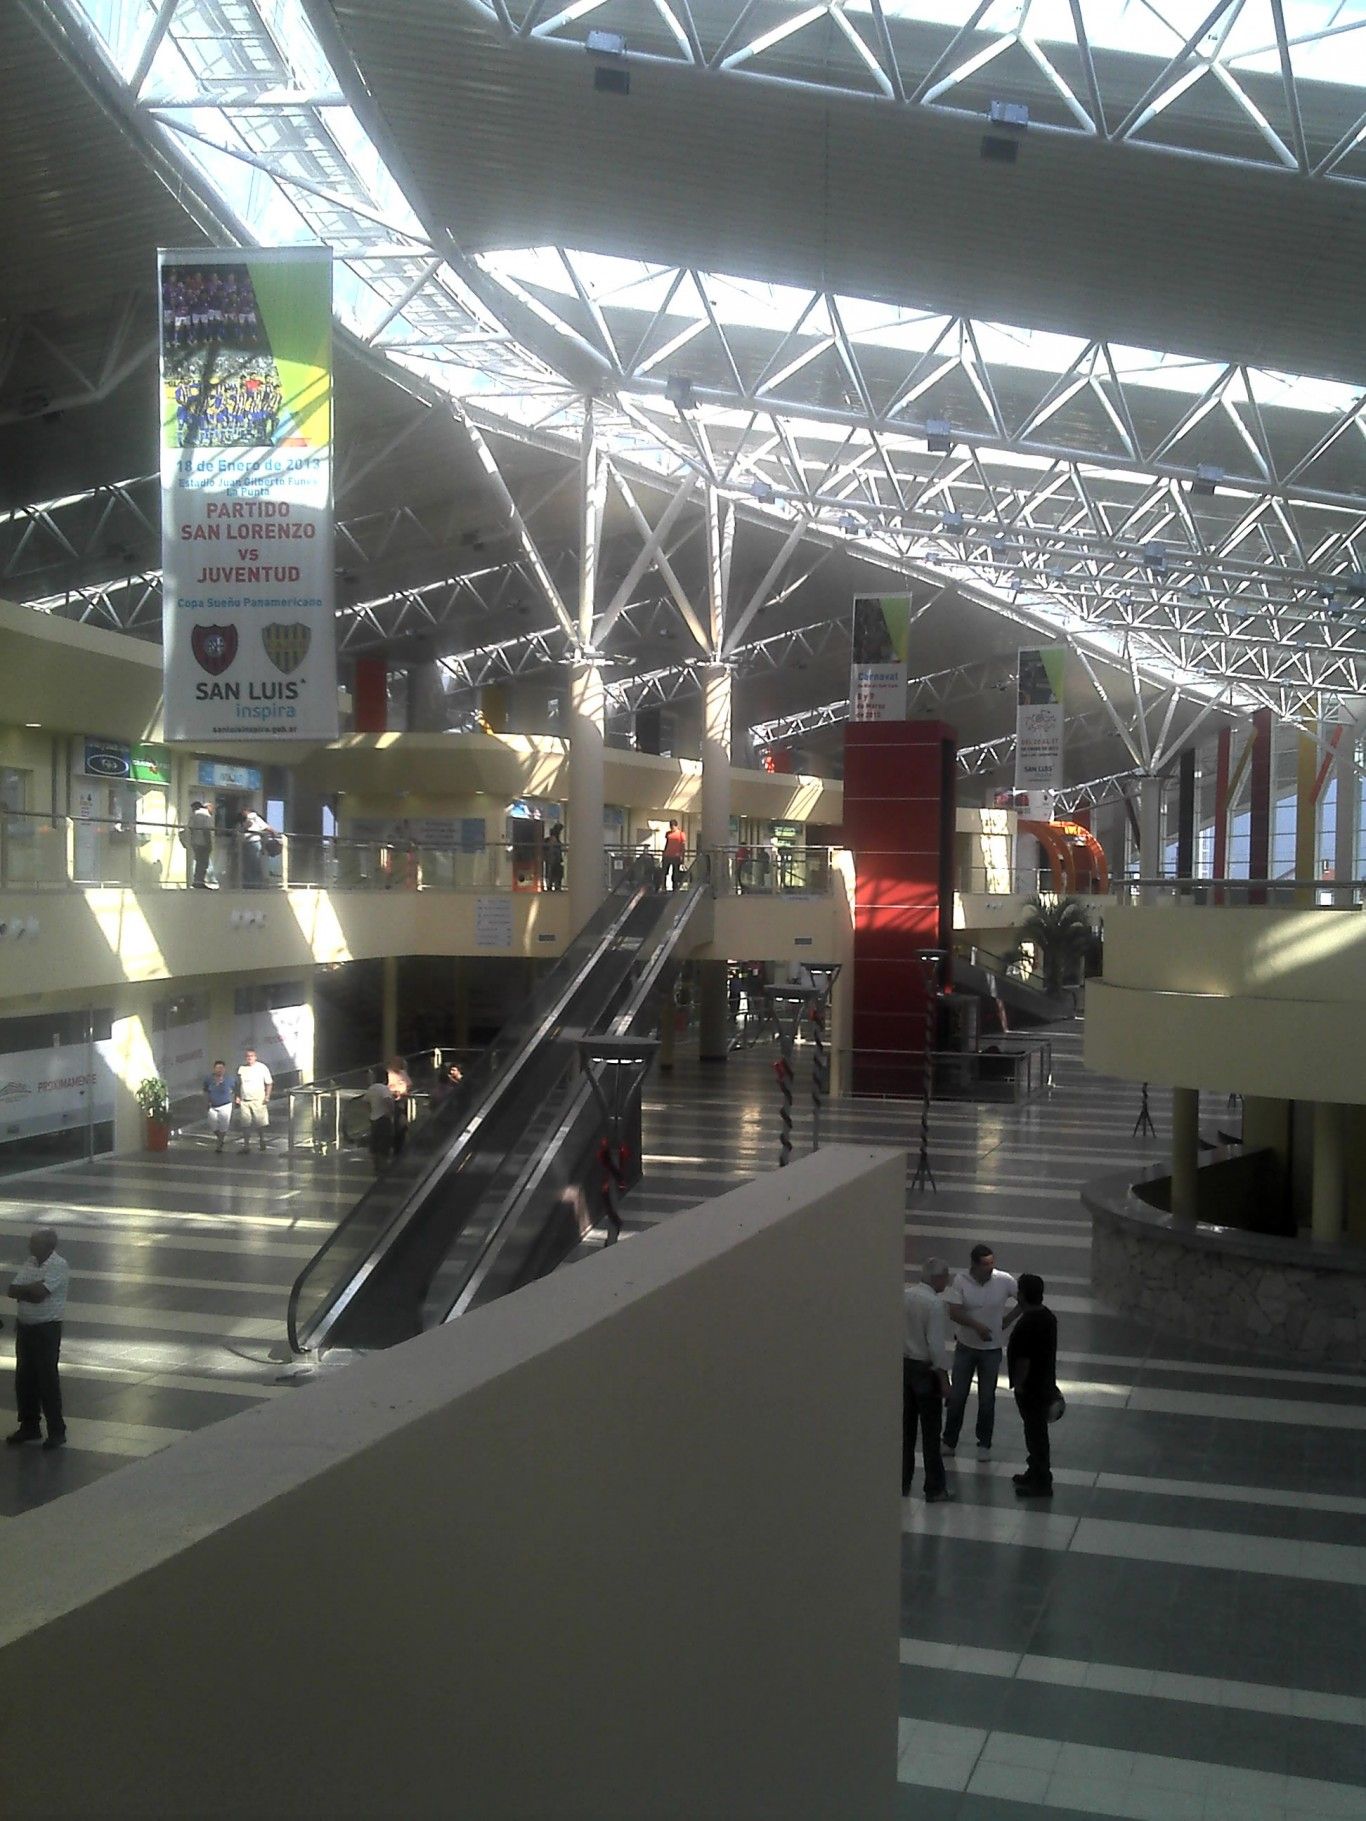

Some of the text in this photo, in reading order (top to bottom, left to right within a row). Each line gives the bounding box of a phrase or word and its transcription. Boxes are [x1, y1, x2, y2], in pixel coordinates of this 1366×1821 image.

[177, 458, 320, 472] 18 de Enero de 2013
[178, 478, 215, 488] Estadio
[218, 477, 242, 487] Juan
[243, 476, 285, 486] Gilberto
[206, 501, 290, 519] PARTIDO
[181, 523, 316, 540] SAN LORENZO
[197, 566, 300, 584] JUVENTUD
[177, 597, 323, 609] Copa Sueño Panamericano
[195, 681, 299, 701] SAN LUIS
[236, 703, 297, 721] inspira
